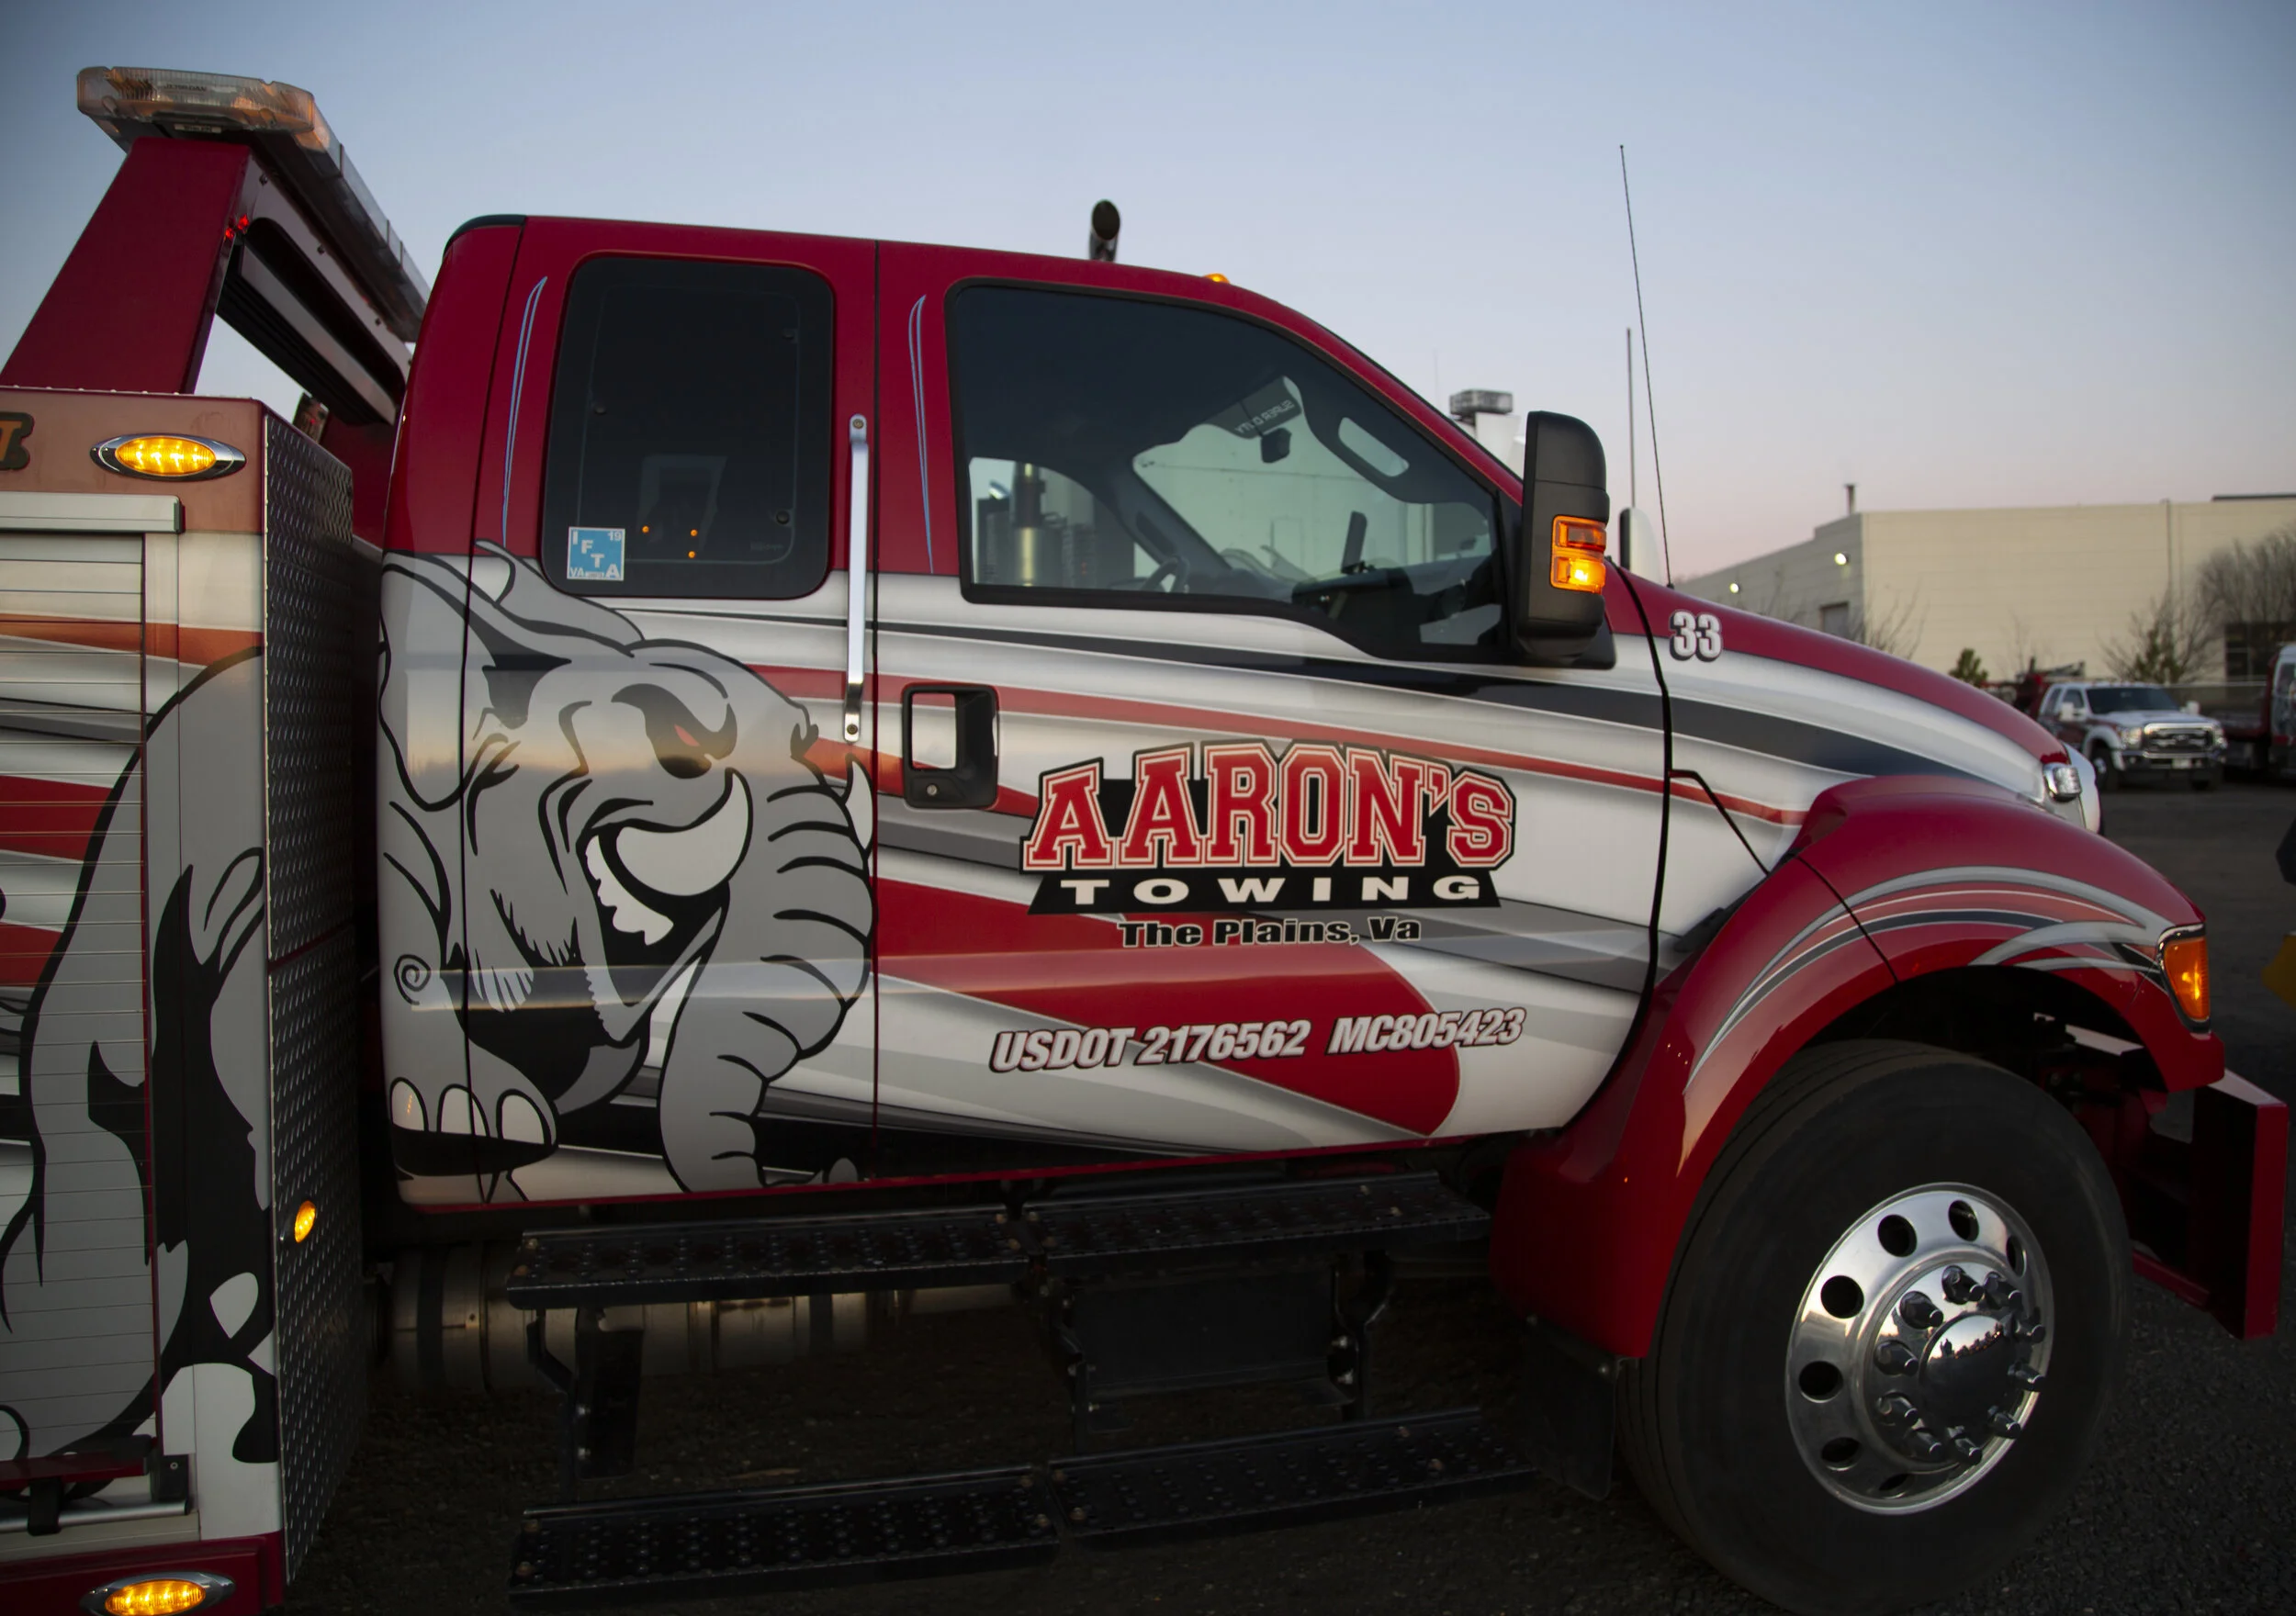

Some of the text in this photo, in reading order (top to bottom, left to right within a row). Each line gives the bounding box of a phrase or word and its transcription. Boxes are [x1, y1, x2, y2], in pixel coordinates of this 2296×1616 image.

[607, 531, 622, 542] 19
[570, 567, 584, 578] VA
[1669, 610, 1723, 661] 33
[1021, 740, 1515, 872] AARON'S
[1060, 875, 1480, 904] TOWING
[1117, 916, 1422, 948] The Plains, Va
[992, 1007, 1527, 1072] USDOT 2176562 MC805423
